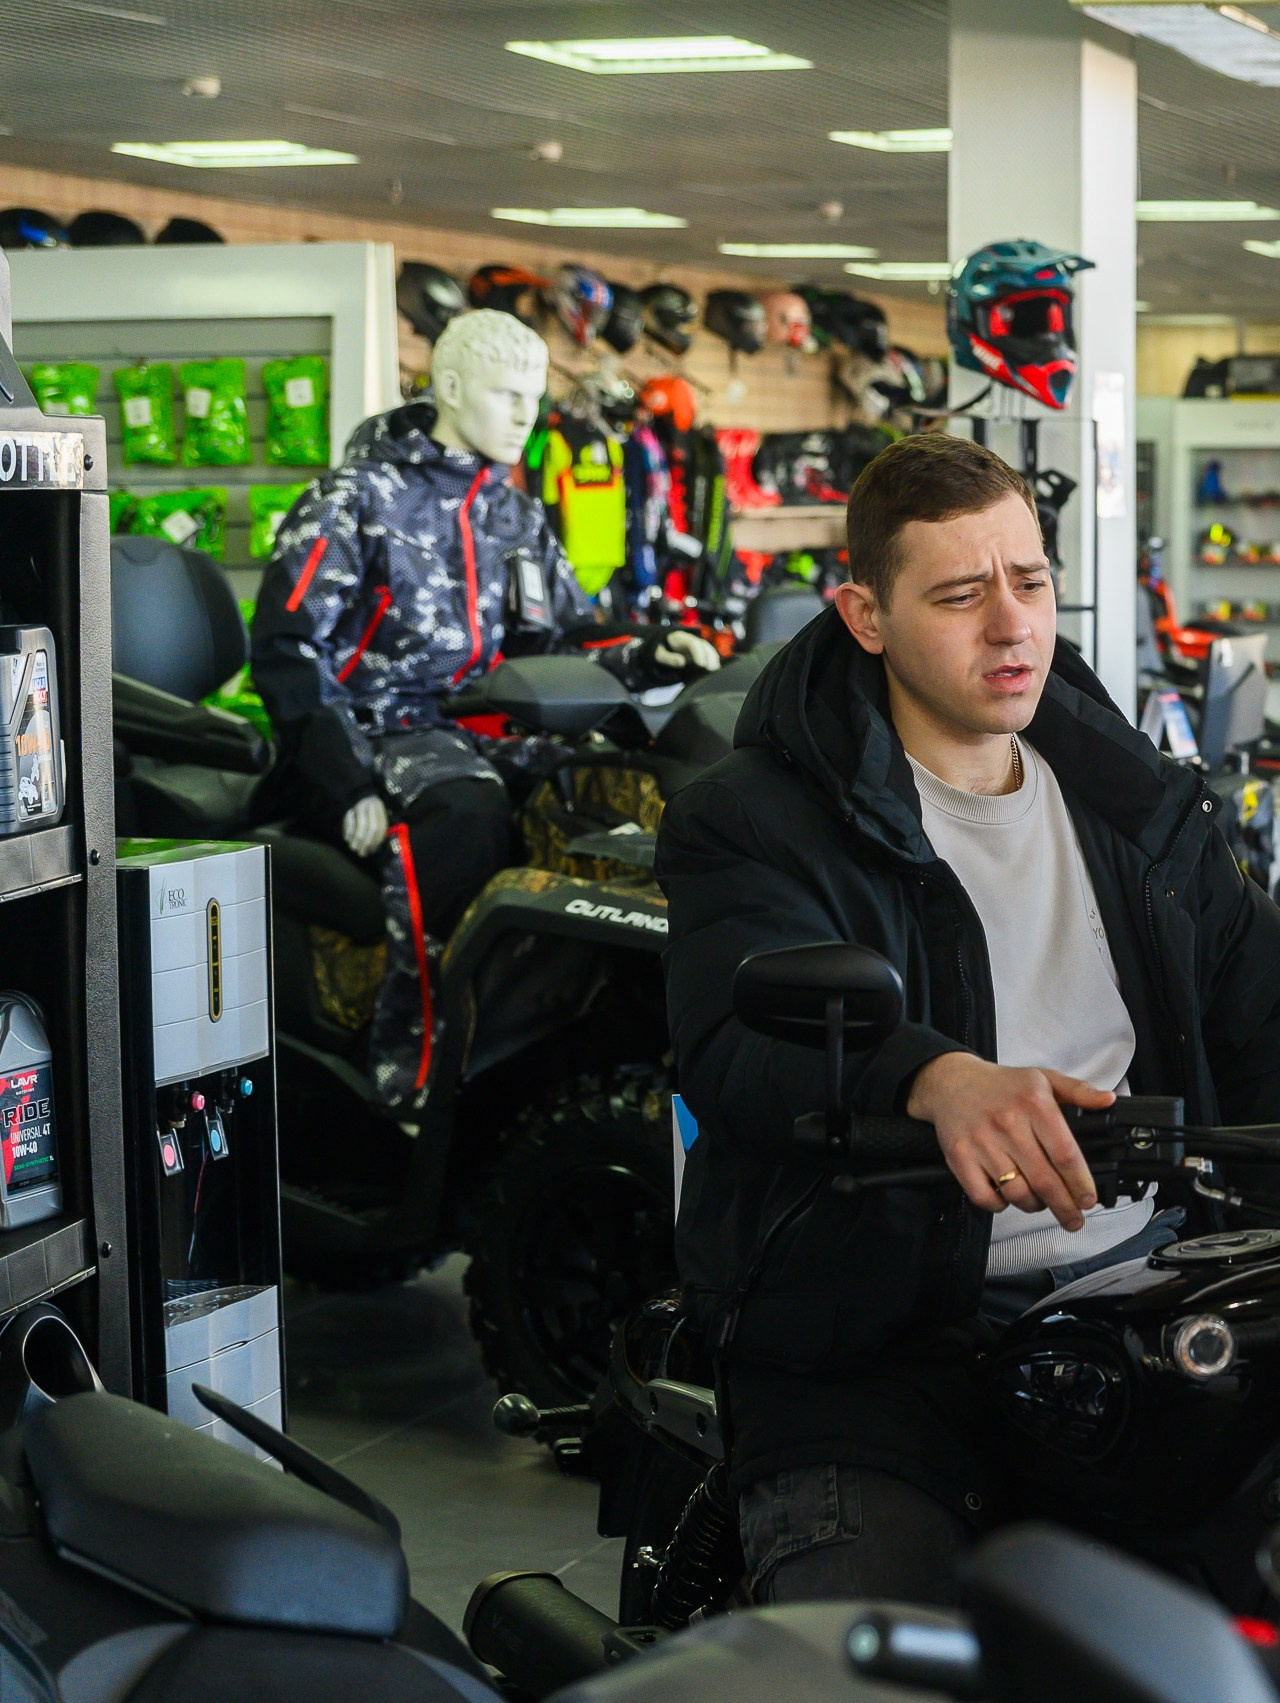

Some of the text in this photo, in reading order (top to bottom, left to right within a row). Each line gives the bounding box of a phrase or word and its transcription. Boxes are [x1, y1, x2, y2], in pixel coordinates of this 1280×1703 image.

[168, 888, 185, 901] ECO
[10, 1074, 38, 1088] LAVR
[2, 1097, 51, 1128] RIDE
[10, 1123, 51, 1145] UNIVERSAL 4T
[12, 1141, 38, 1159] 10W-40
